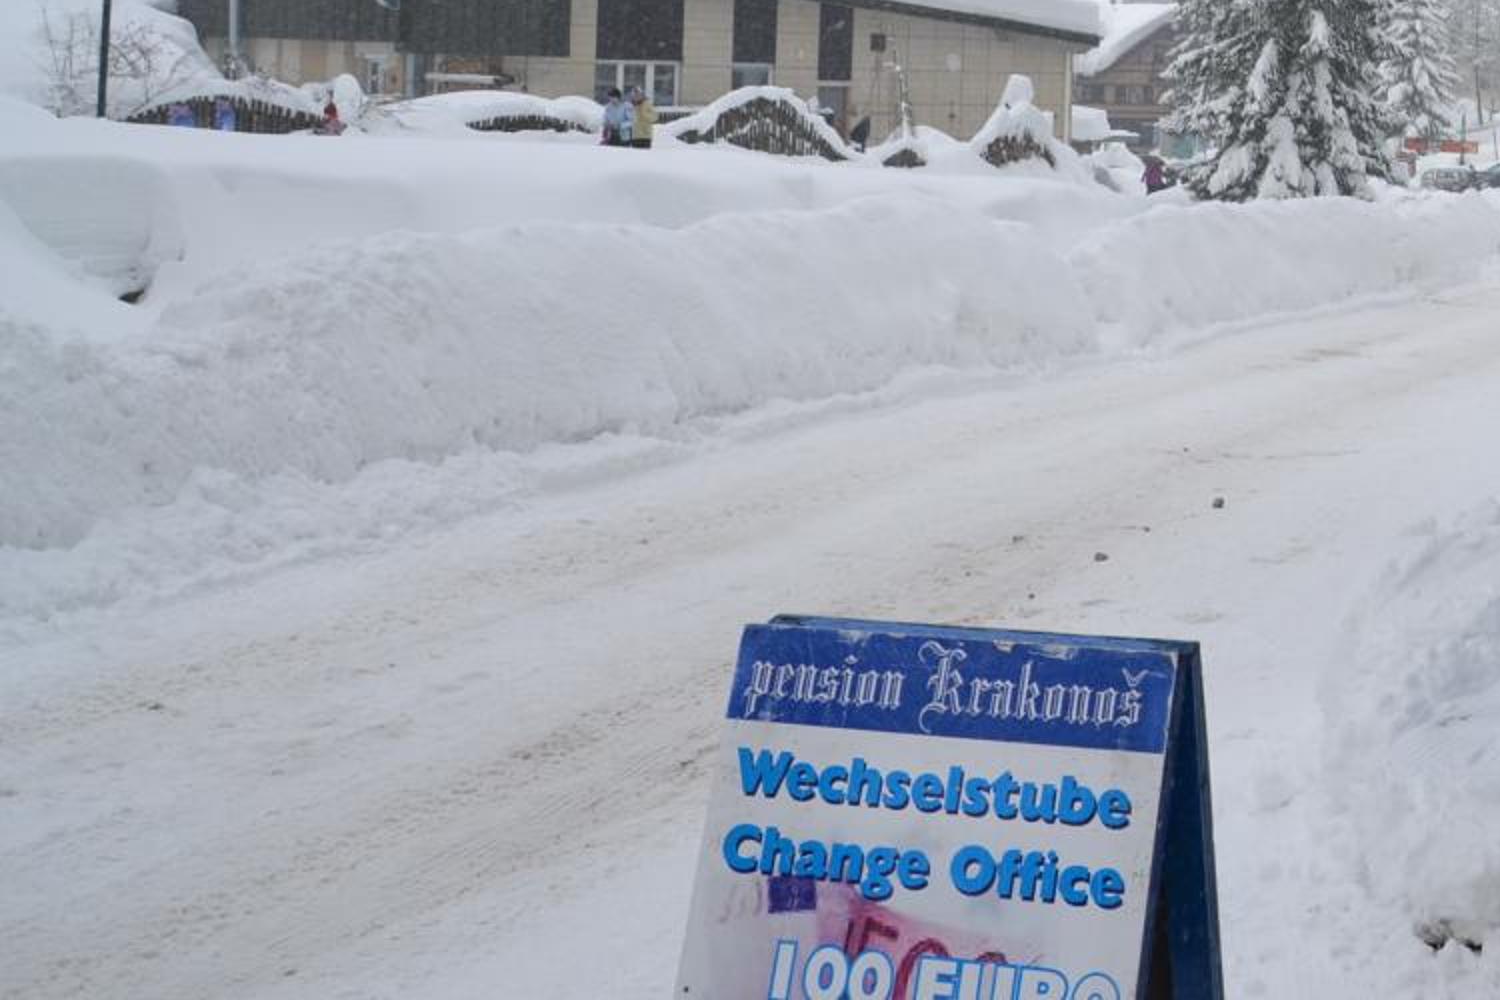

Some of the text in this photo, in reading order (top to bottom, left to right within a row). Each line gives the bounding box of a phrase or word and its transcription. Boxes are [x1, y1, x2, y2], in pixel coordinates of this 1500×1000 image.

[744, 654, 905, 719] pension
[737, 746, 1133, 829] Wechselstube
[722, 823, 1126, 909] Change Office
[767, 939, 897, 1000] 100
